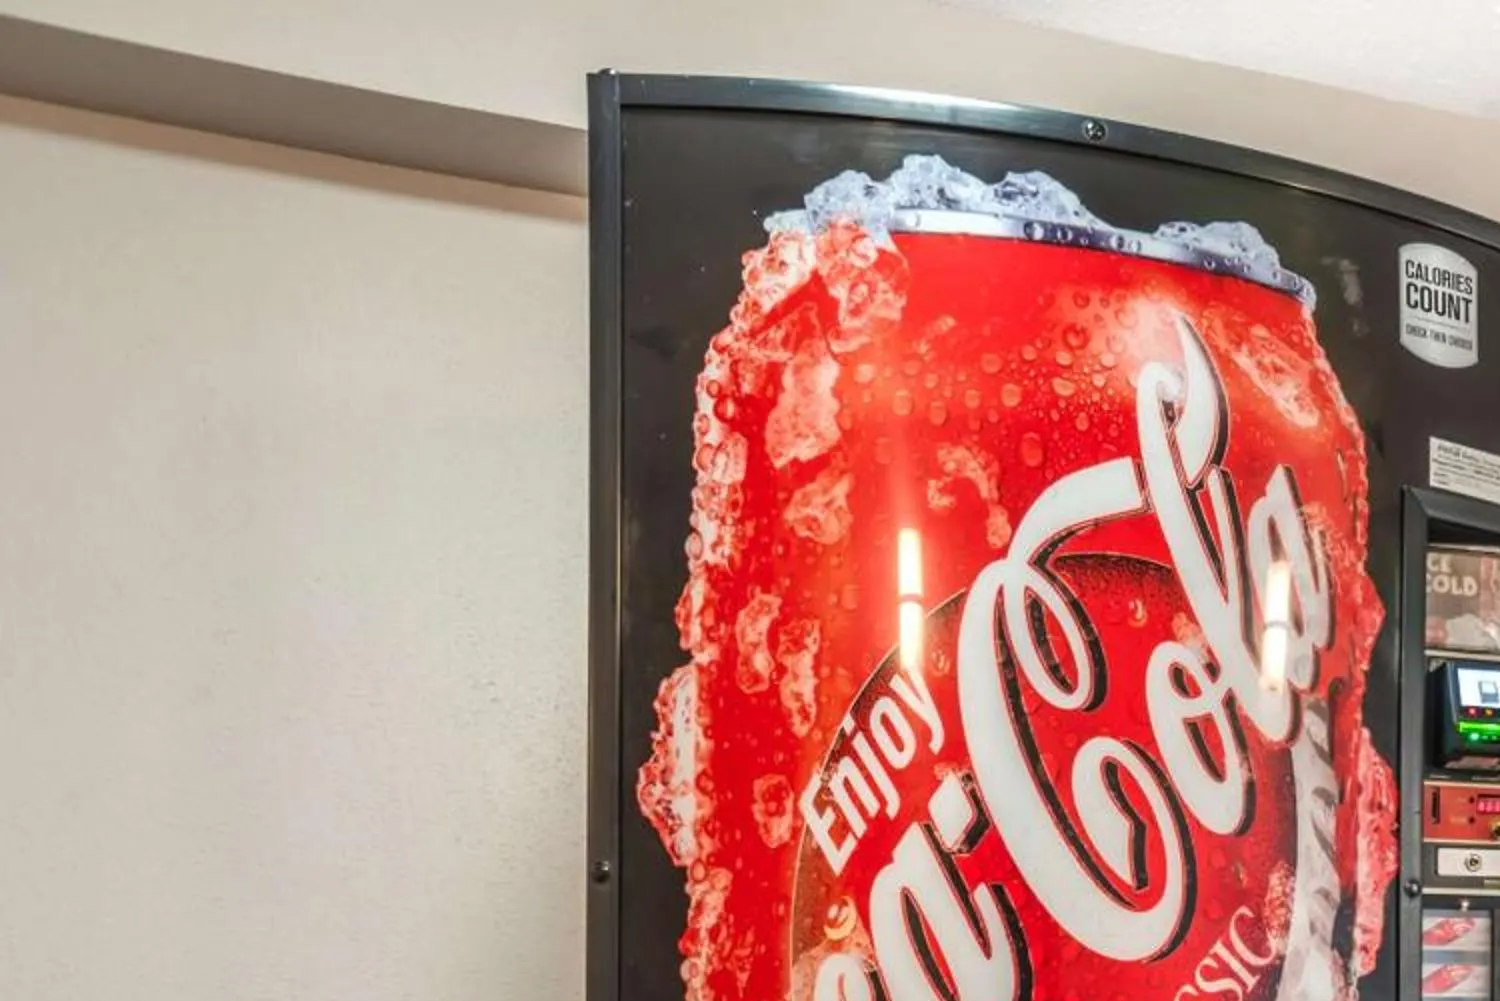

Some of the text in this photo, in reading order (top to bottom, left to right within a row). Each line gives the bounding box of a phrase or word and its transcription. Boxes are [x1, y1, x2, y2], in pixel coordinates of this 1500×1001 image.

[1405, 259, 1473, 295] CALORIES
[1405, 281, 1473, 324] COUNT
[1426, 551, 1453, 574] CE
[803, 666, 947, 876] Enjoy
